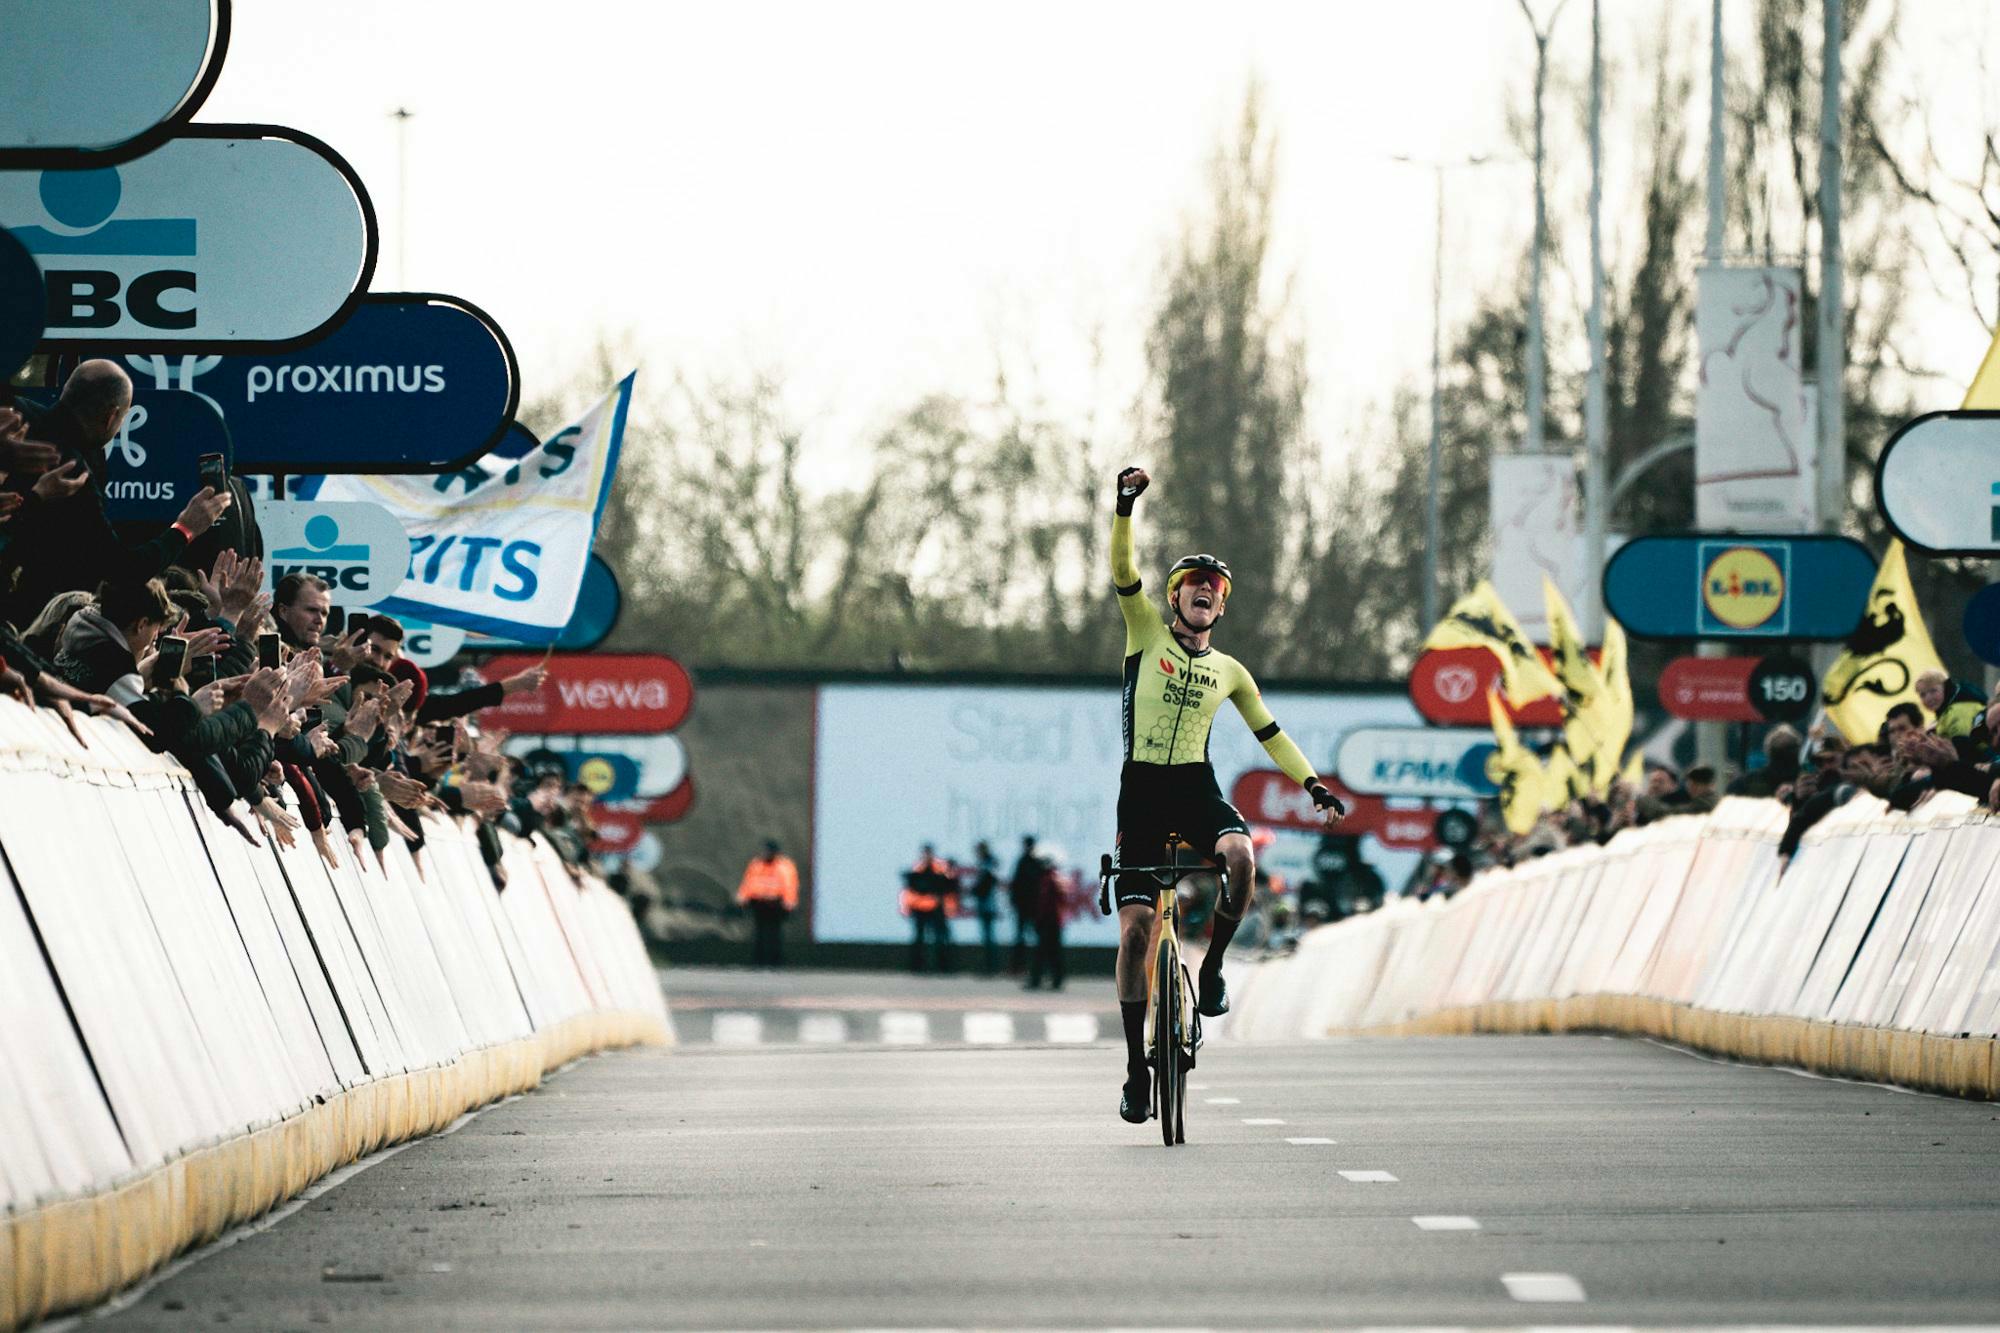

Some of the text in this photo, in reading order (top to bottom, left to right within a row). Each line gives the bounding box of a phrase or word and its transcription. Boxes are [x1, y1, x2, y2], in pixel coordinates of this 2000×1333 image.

[44, 269, 197, 330] BC
[247, 365, 446, 402] proximus
[1165, 679, 1204, 699] lease
[1179, 667, 1218, 689] VISMA
[1761, 676, 1807, 702] 150
